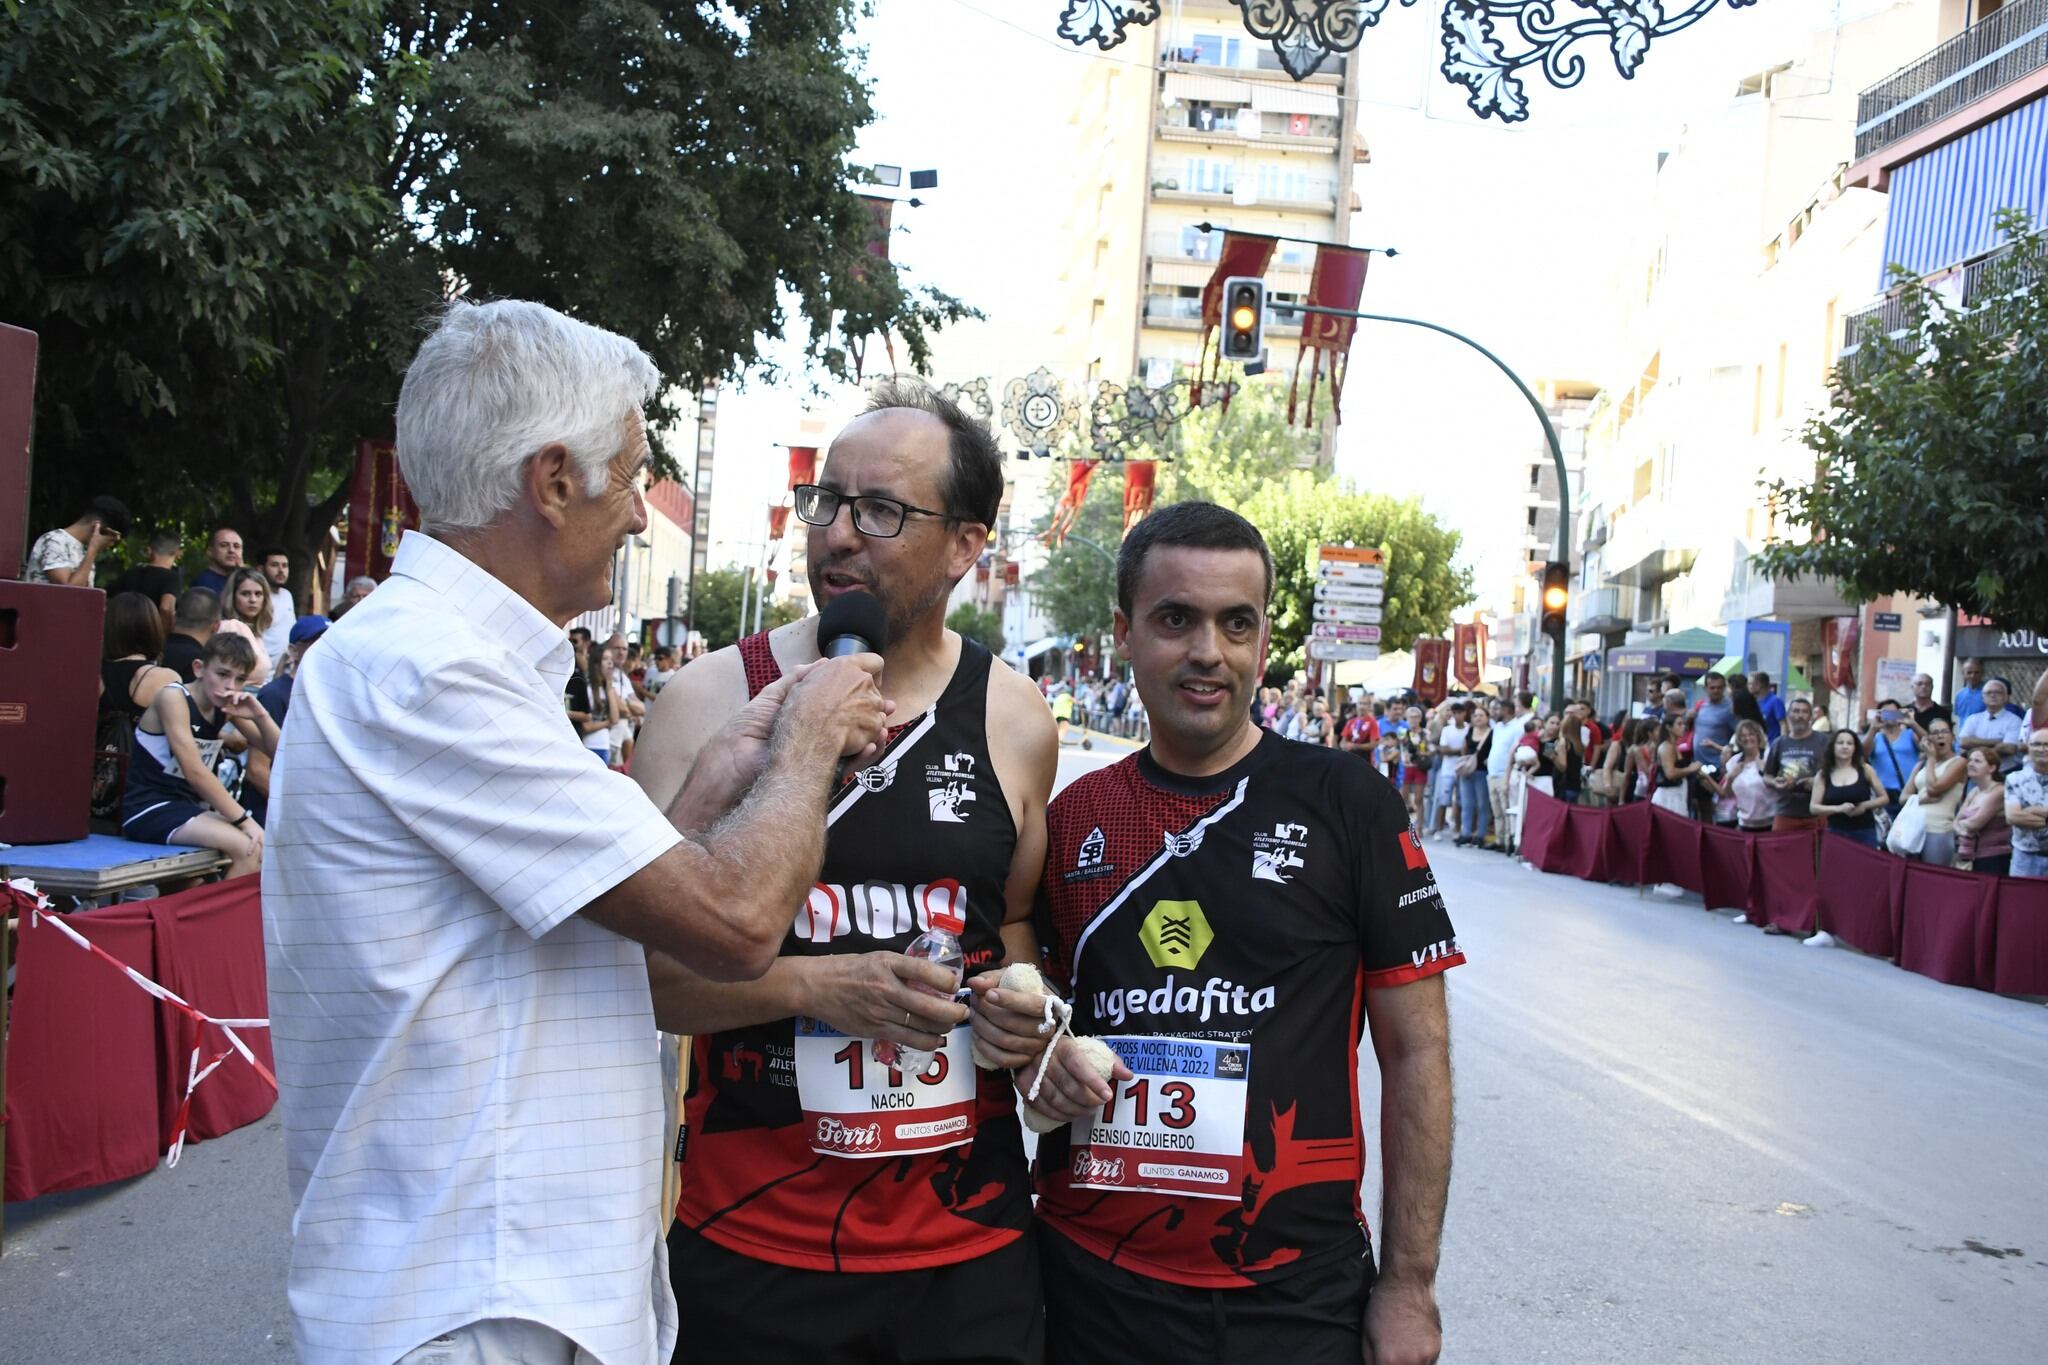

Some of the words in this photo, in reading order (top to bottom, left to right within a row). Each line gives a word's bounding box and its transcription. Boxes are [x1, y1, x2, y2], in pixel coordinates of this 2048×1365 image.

[1207, 1028, 1254, 1038] STRATEGY
[766, 1044, 794, 1056] CLUB
[1142, 1042, 1203, 1058] NOCTURNO
[1137, 1057, 1178, 1073] VILLENA
[1181, 1060, 1209, 1075] 2022
[769, 1073, 798, 1087] VILLEN
[871, 1092, 915, 1110] NACHO
[1102, 1078, 1197, 1129] 113
[818, 1118, 879, 1149] Ferri
[899, 1126, 932, 1138] JUNTOS
[933, 1119, 966, 1133] GANAMOS
[1133, 1131, 1195, 1150] IZQUIERDO
[1074, 1150, 1121, 1179] Ferri
[1142, 1166, 1175, 1177] JUNTOS
[1178, 1169, 1224, 1181] GANAMOS
